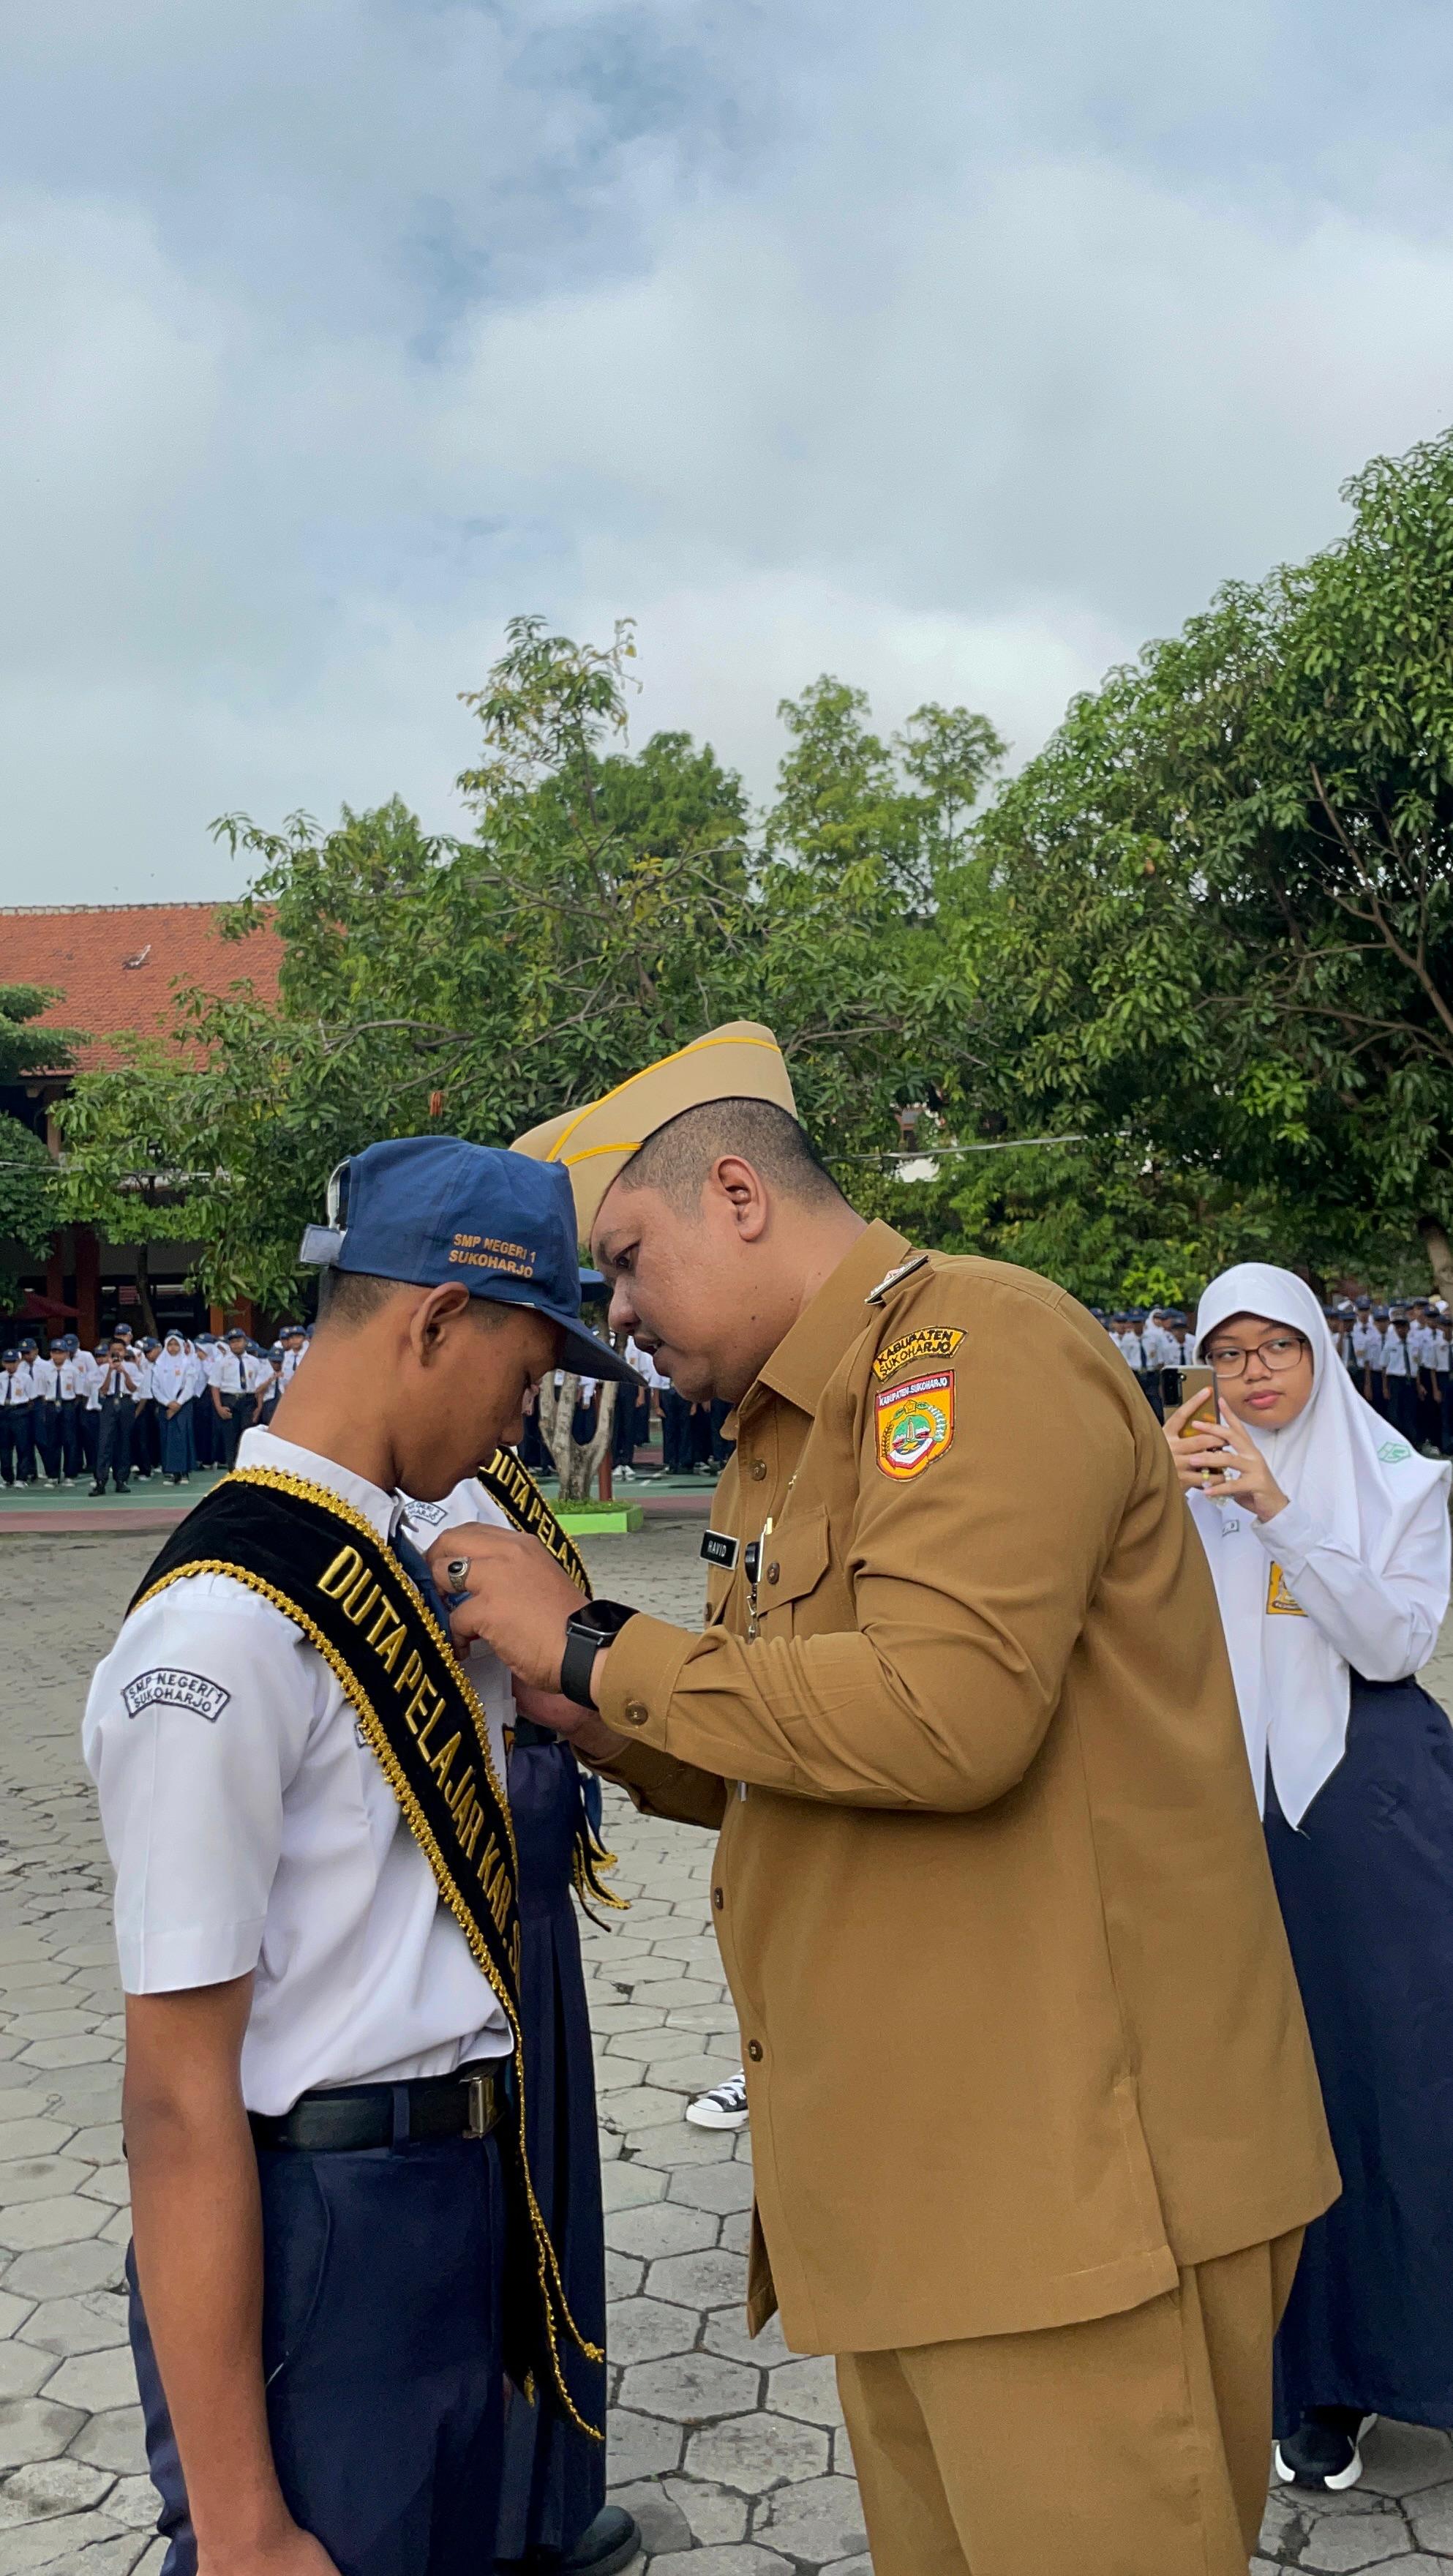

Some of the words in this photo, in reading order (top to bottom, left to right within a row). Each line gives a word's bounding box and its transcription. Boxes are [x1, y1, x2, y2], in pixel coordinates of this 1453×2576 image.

[448, 1249, 533, 1278] SUKOHARJO
[454, 1233, 481, 1248] SMP
[484, 1238, 527, 1260] NEGERI
[530, 1251, 536, 1263] 1
[878, 1330, 953, 1365] KABUPATEN
[879, 1341, 951, 1376] SUKOHARJO
[129, 1677, 152, 1699] SMP
[157, 1672, 214, 1698] NEGERI
[214, 1693, 223, 1704] 1
[134, 1687, 212, 1712] SUKOHARJO
[317, 1545, 408, 1674] DUTA
[394, 1649, 484, 1862] PELAJAR
